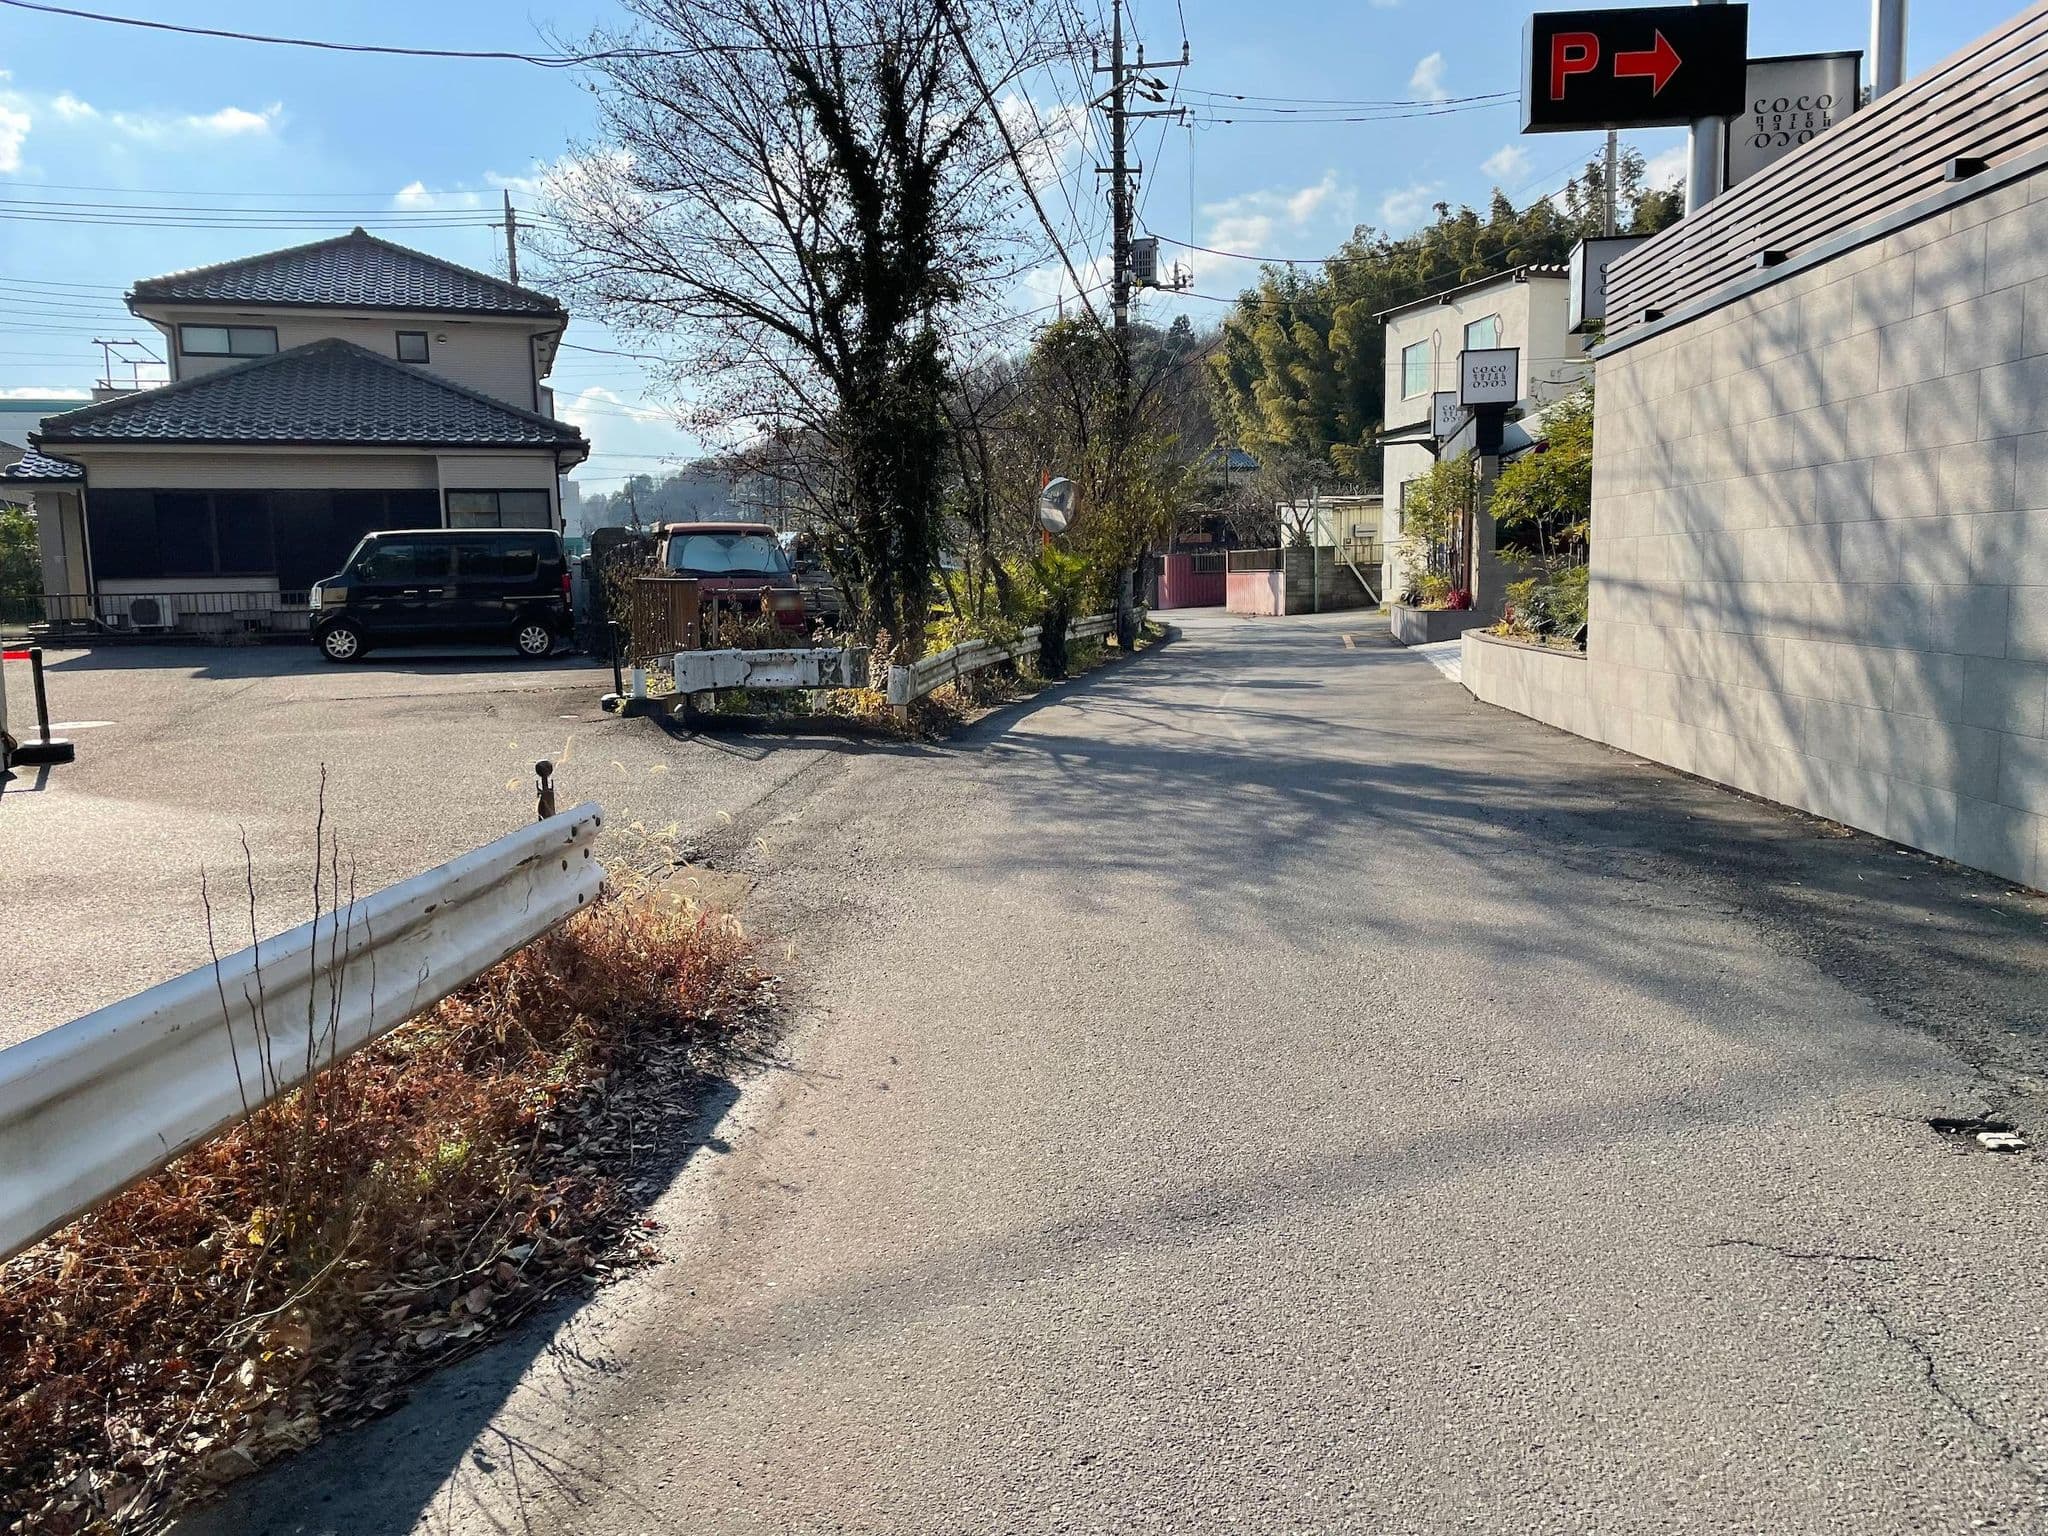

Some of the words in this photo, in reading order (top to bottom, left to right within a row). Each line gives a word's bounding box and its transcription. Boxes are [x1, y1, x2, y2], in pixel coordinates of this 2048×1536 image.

[1550, 31, 1600, 101] P
[1754, 94, 1842, 114] COCO
[1756, 111, 1830, 124] HOTEL
[1745, 128, 1829, 149] OCO
